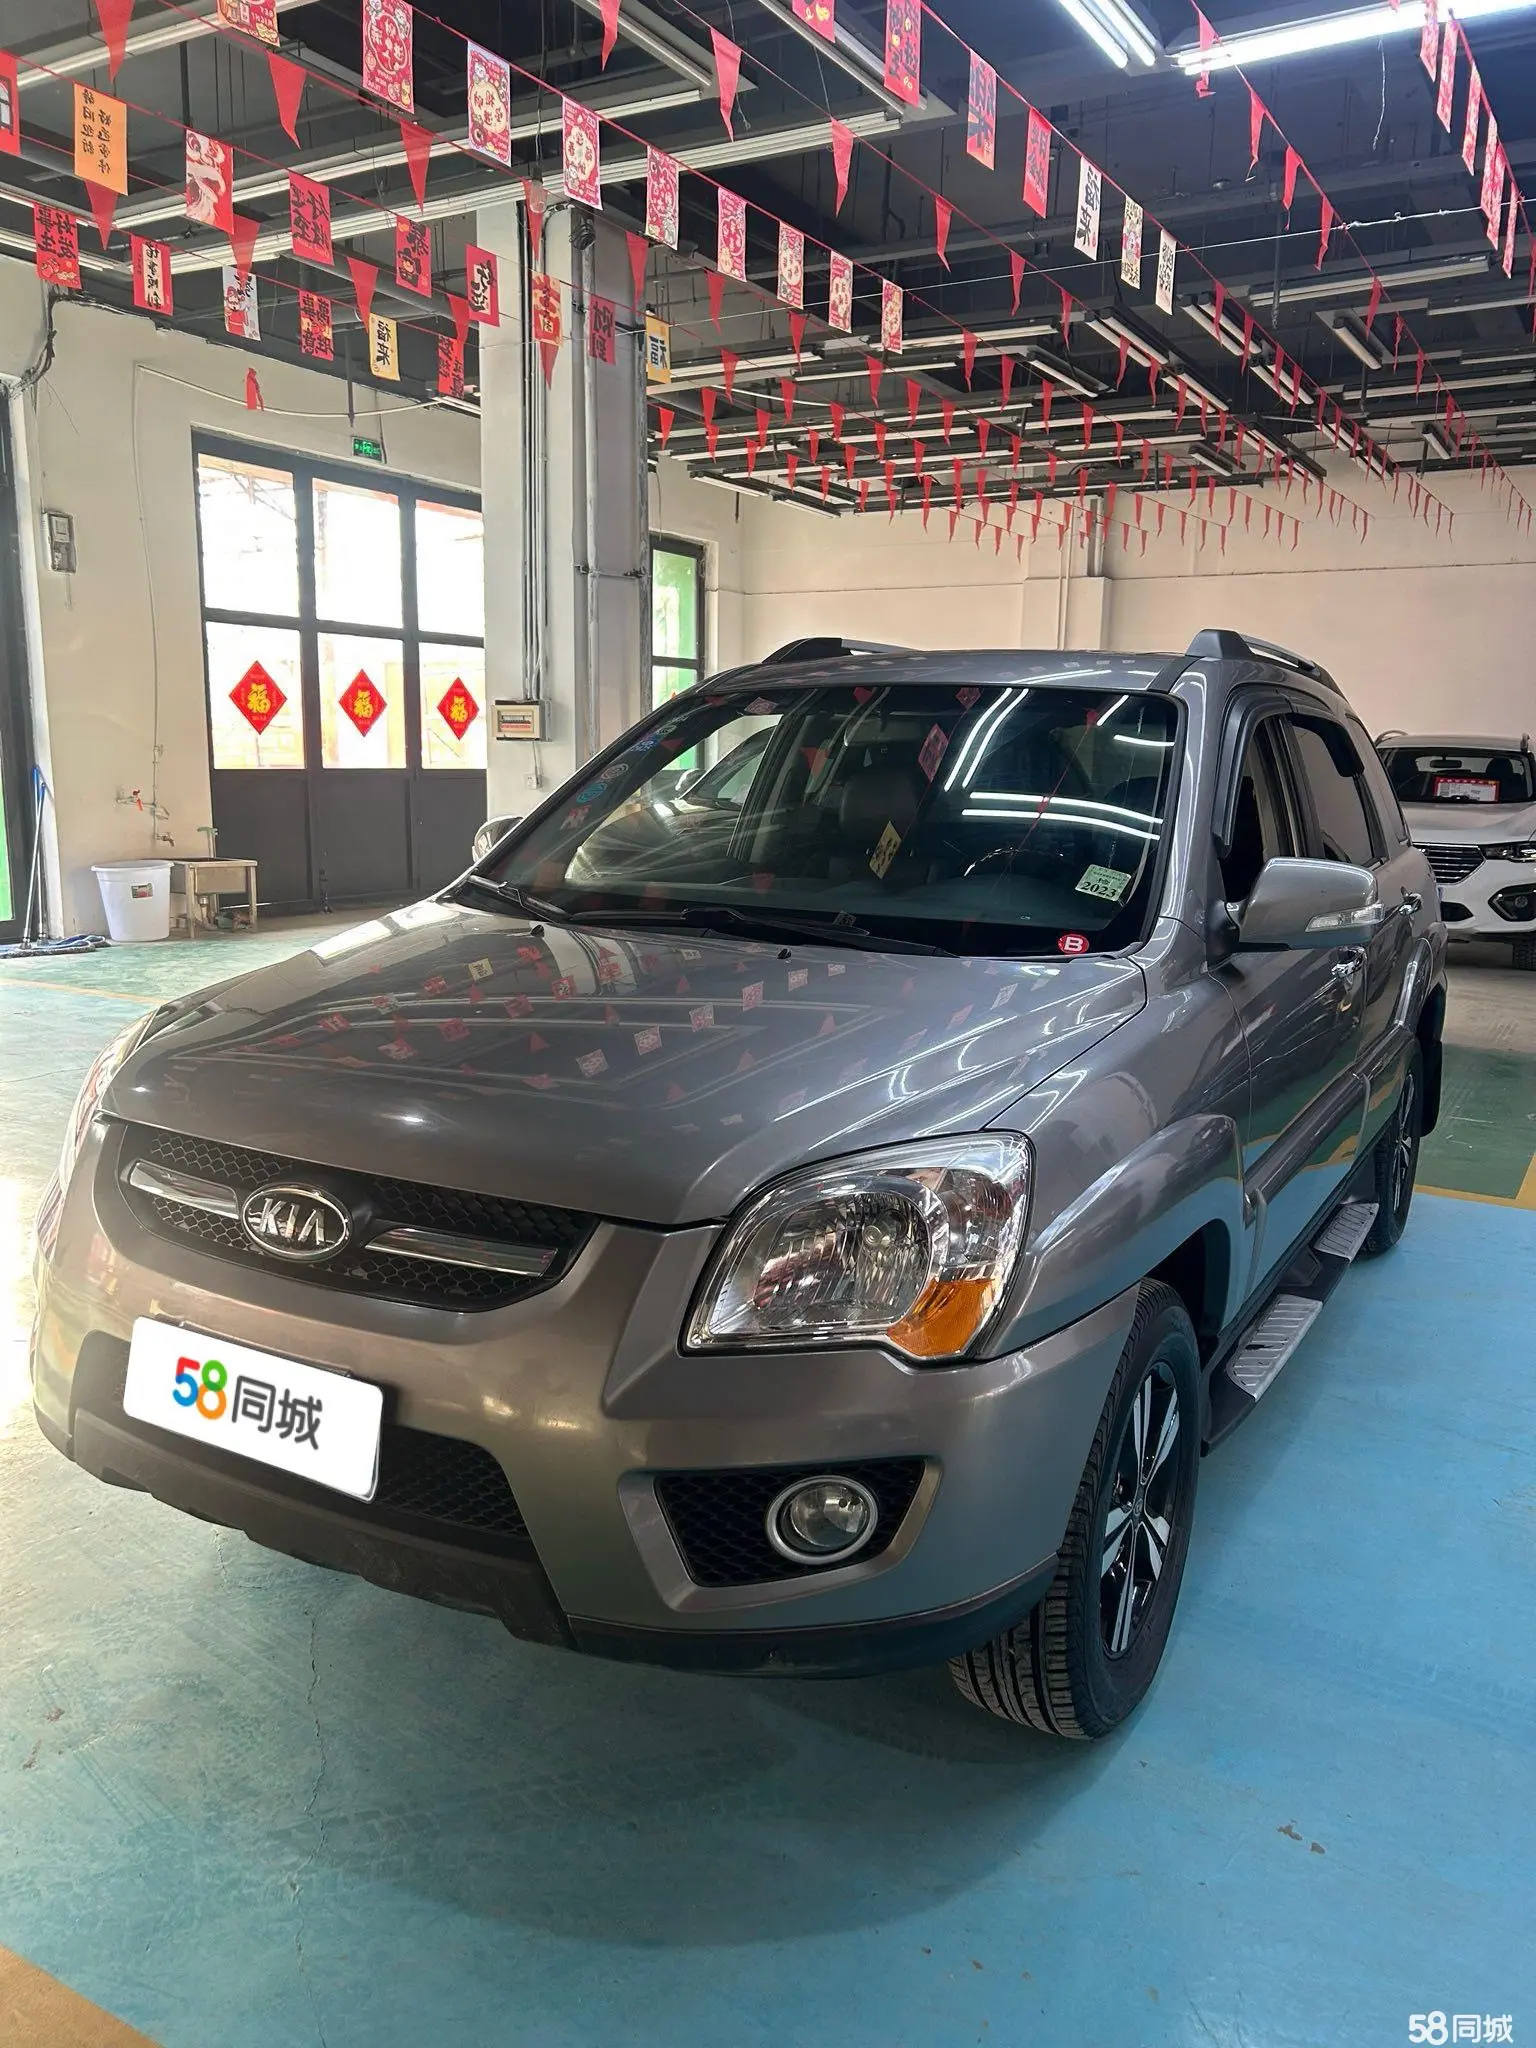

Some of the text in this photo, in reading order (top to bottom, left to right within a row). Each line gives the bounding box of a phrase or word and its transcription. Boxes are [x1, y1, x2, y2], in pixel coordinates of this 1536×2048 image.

[248, 682, 271, 713] 福
[354, 689, 373, 718] 福
[450, 696, 468, 722] 福
[1081, 881, 1117, 898] 2023
[1063, 936, 1084, 952] B
[257, 1197, 327, 1247] KIA
